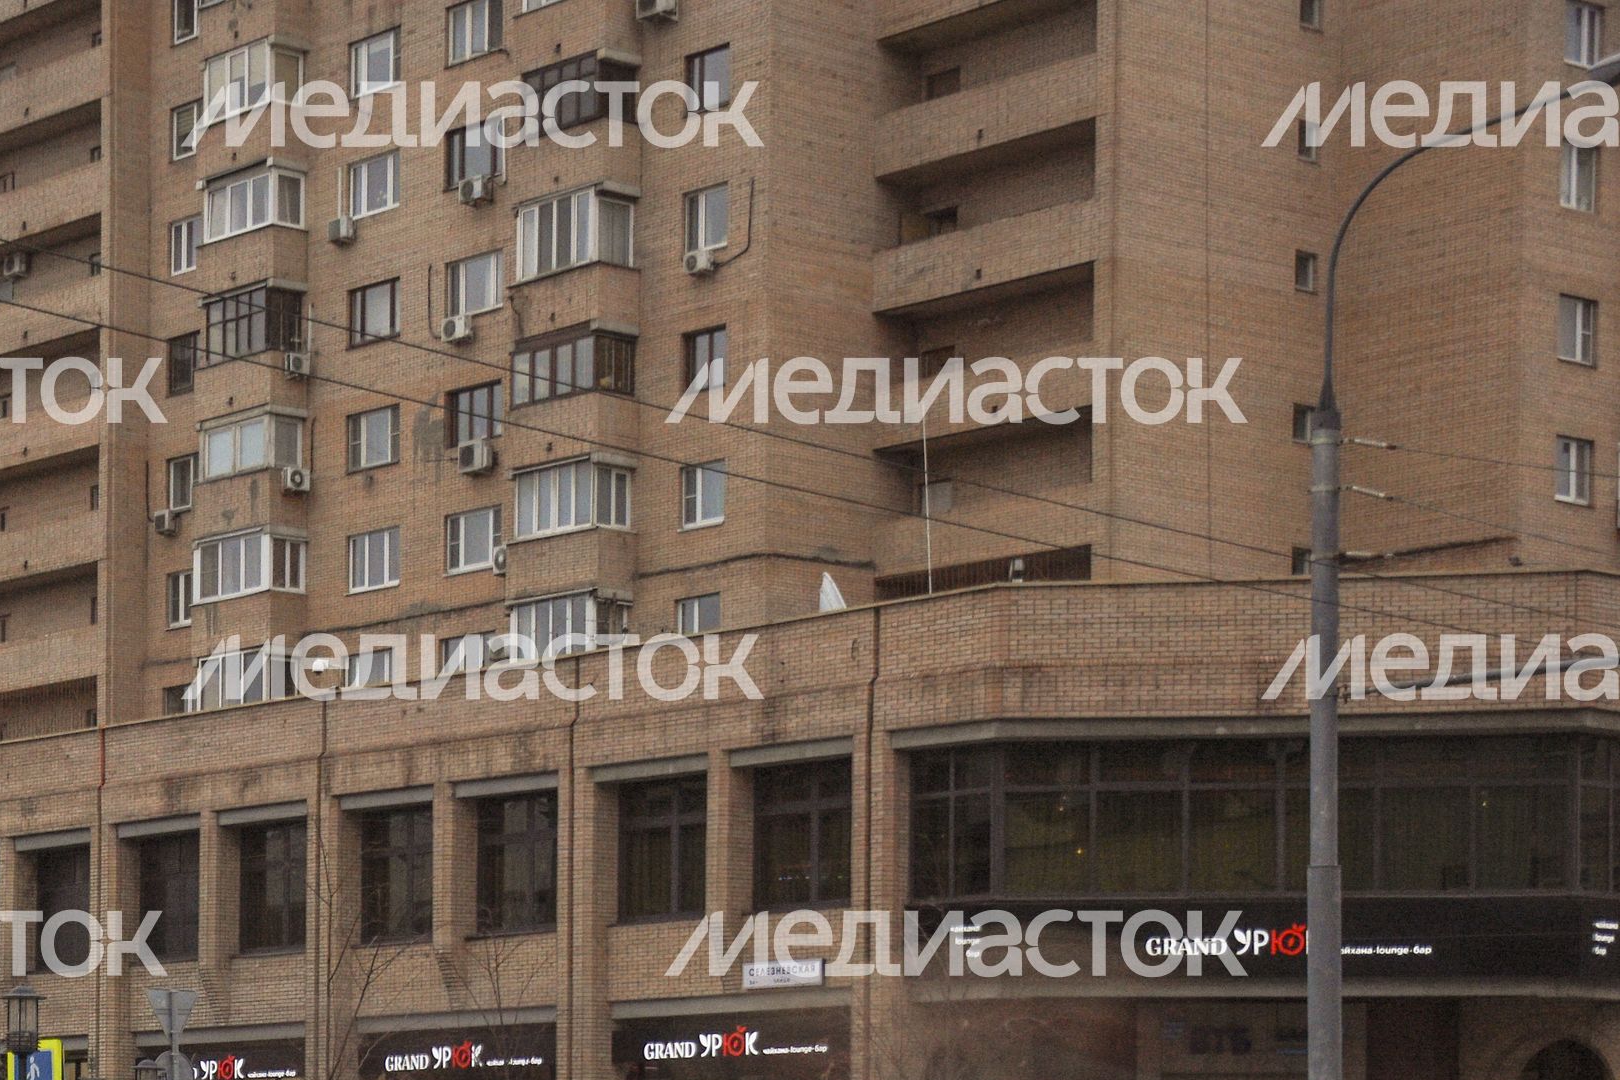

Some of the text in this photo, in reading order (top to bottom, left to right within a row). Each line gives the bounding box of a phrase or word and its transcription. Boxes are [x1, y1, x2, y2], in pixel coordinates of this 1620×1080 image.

[1145, 936, 1227, 956] GRAND
[385, 1054, 429, 1072] GRAND
[431, 1040, 483, 1070] УРЮК
[644, 1041, 697, 1060] GRAND
[699, 1025, 759, 1058] УРЮК
[200, 1055, 245, 1080] УРЮК
